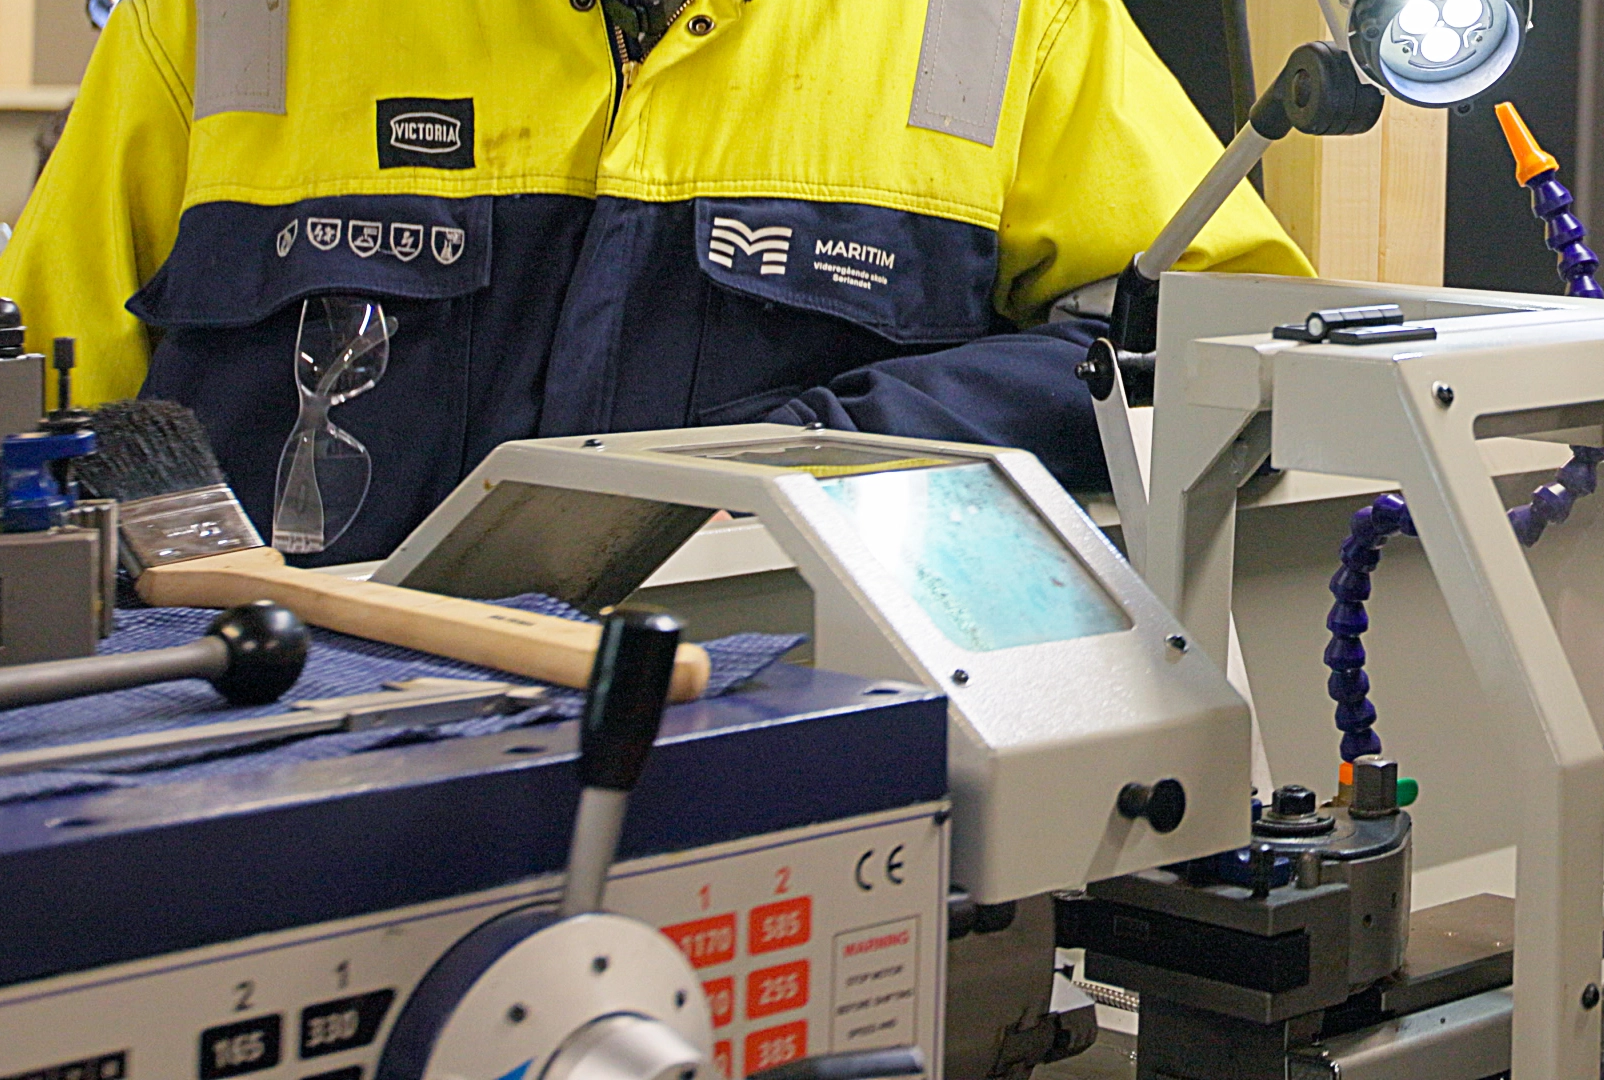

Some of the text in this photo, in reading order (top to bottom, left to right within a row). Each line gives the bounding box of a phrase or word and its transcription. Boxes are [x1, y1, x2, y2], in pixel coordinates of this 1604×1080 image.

[395, 122, 456, 142] VICTORIA
[815, 239, 895, 270] MARITIM
[698, 866, 791, 911] 1 2
[233, 960, 350, 1011] 2 1
[758, 973, 800, 1006] 255
